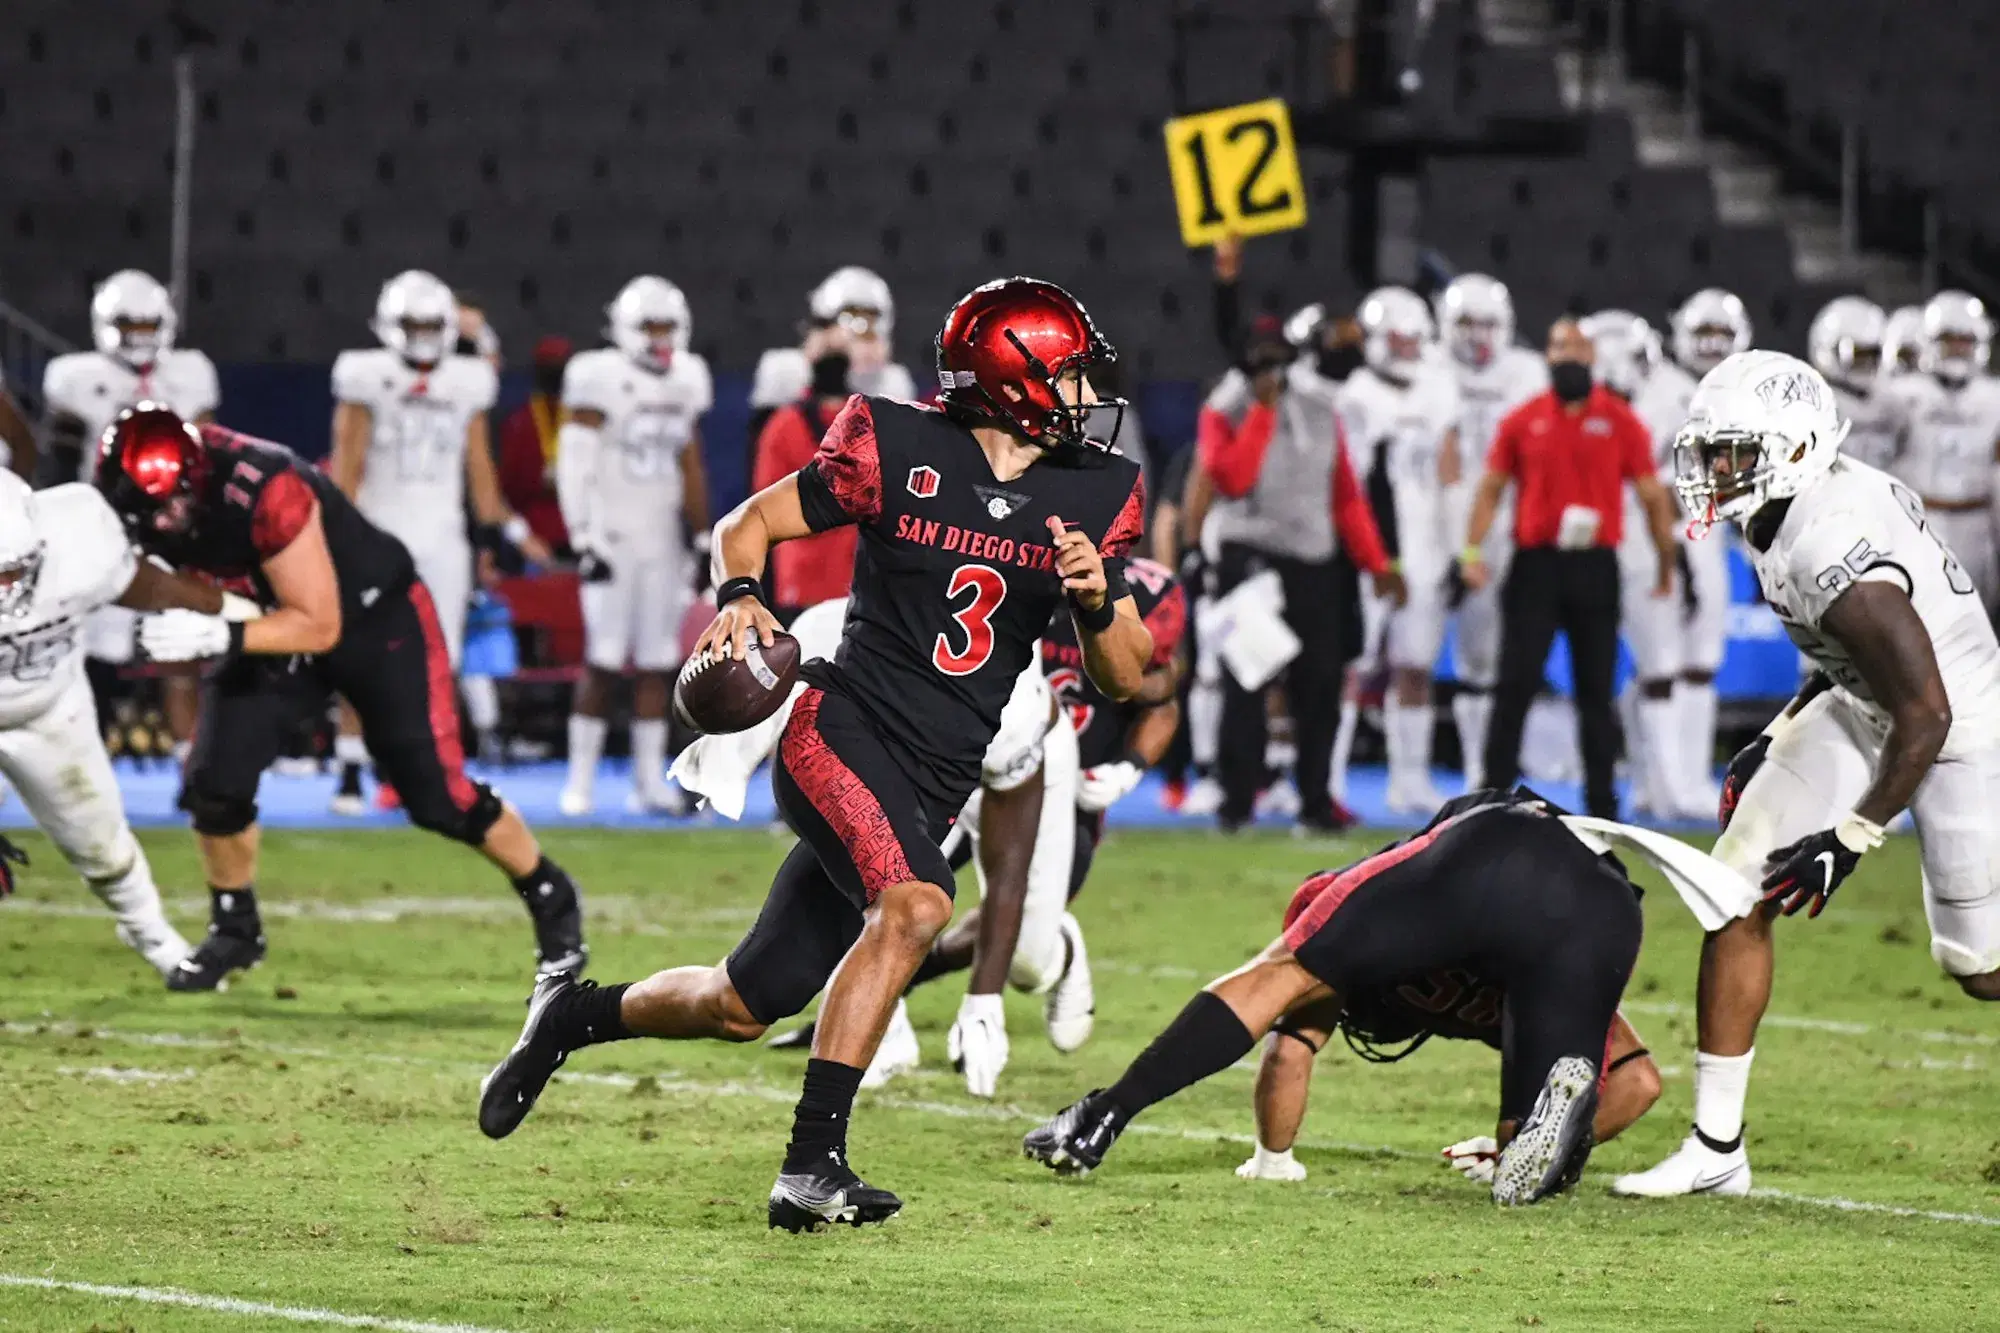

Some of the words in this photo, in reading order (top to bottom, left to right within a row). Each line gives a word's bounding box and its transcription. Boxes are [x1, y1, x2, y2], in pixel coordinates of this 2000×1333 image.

[1184, 117, 1292, 225] 12
[895, 514, 942, 547] SAN
[941, 525, 1020, 564] DIEGO
[1016, 542, 1062, 574] STA
[932, 563, 1007, 677] 3
